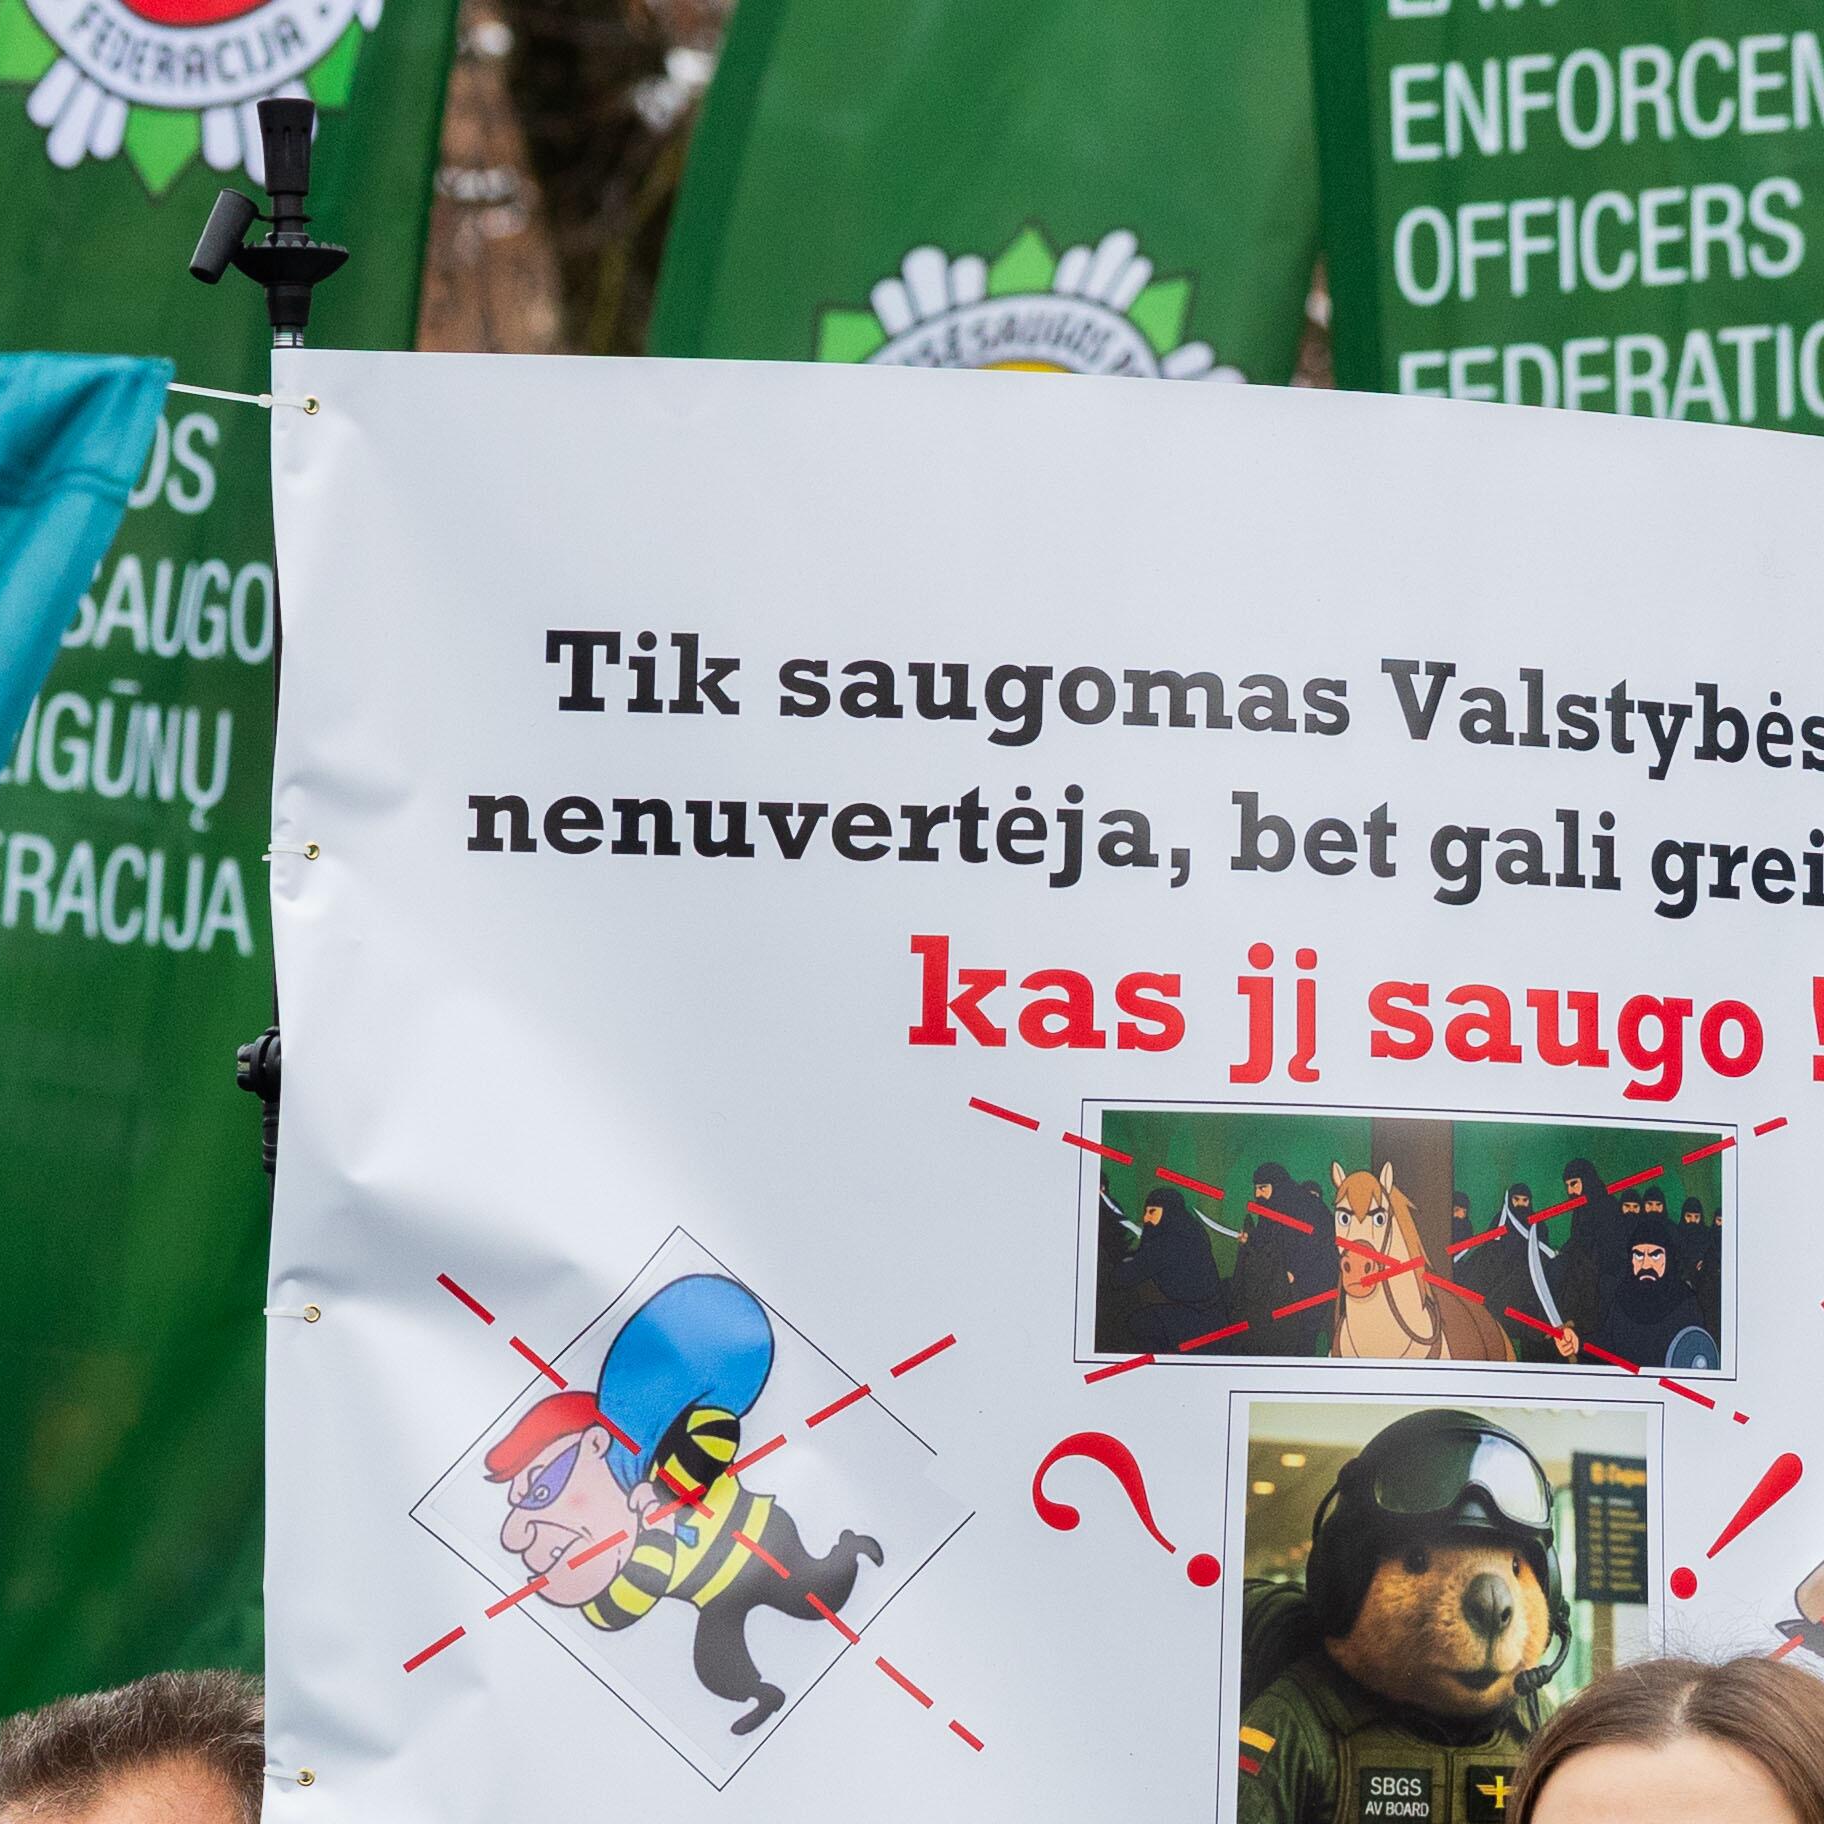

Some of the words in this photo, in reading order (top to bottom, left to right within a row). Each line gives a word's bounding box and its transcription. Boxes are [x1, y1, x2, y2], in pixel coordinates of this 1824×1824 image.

[1392, 177, 1805, 305] OFFICERS
[545, 630, 740, 715] Tik
[778, 654, 1350, 748] saugomas
[466, 785, 1192, 889] nenuvertėja,
[1230, 791, 1398, 877] bet
[1429, 809, 1622, 906] gali
[907, 935, 1188, 1054] kas
[1229, 942, 1321, 1084] jį
[1369, 977, 1765, 1103] saugo
[1365, 1800, 1381, 1816] AV
[1385, 1801, 1429, 1817] BOARD
[1370, 1776, 1423, 1796] SBGS
